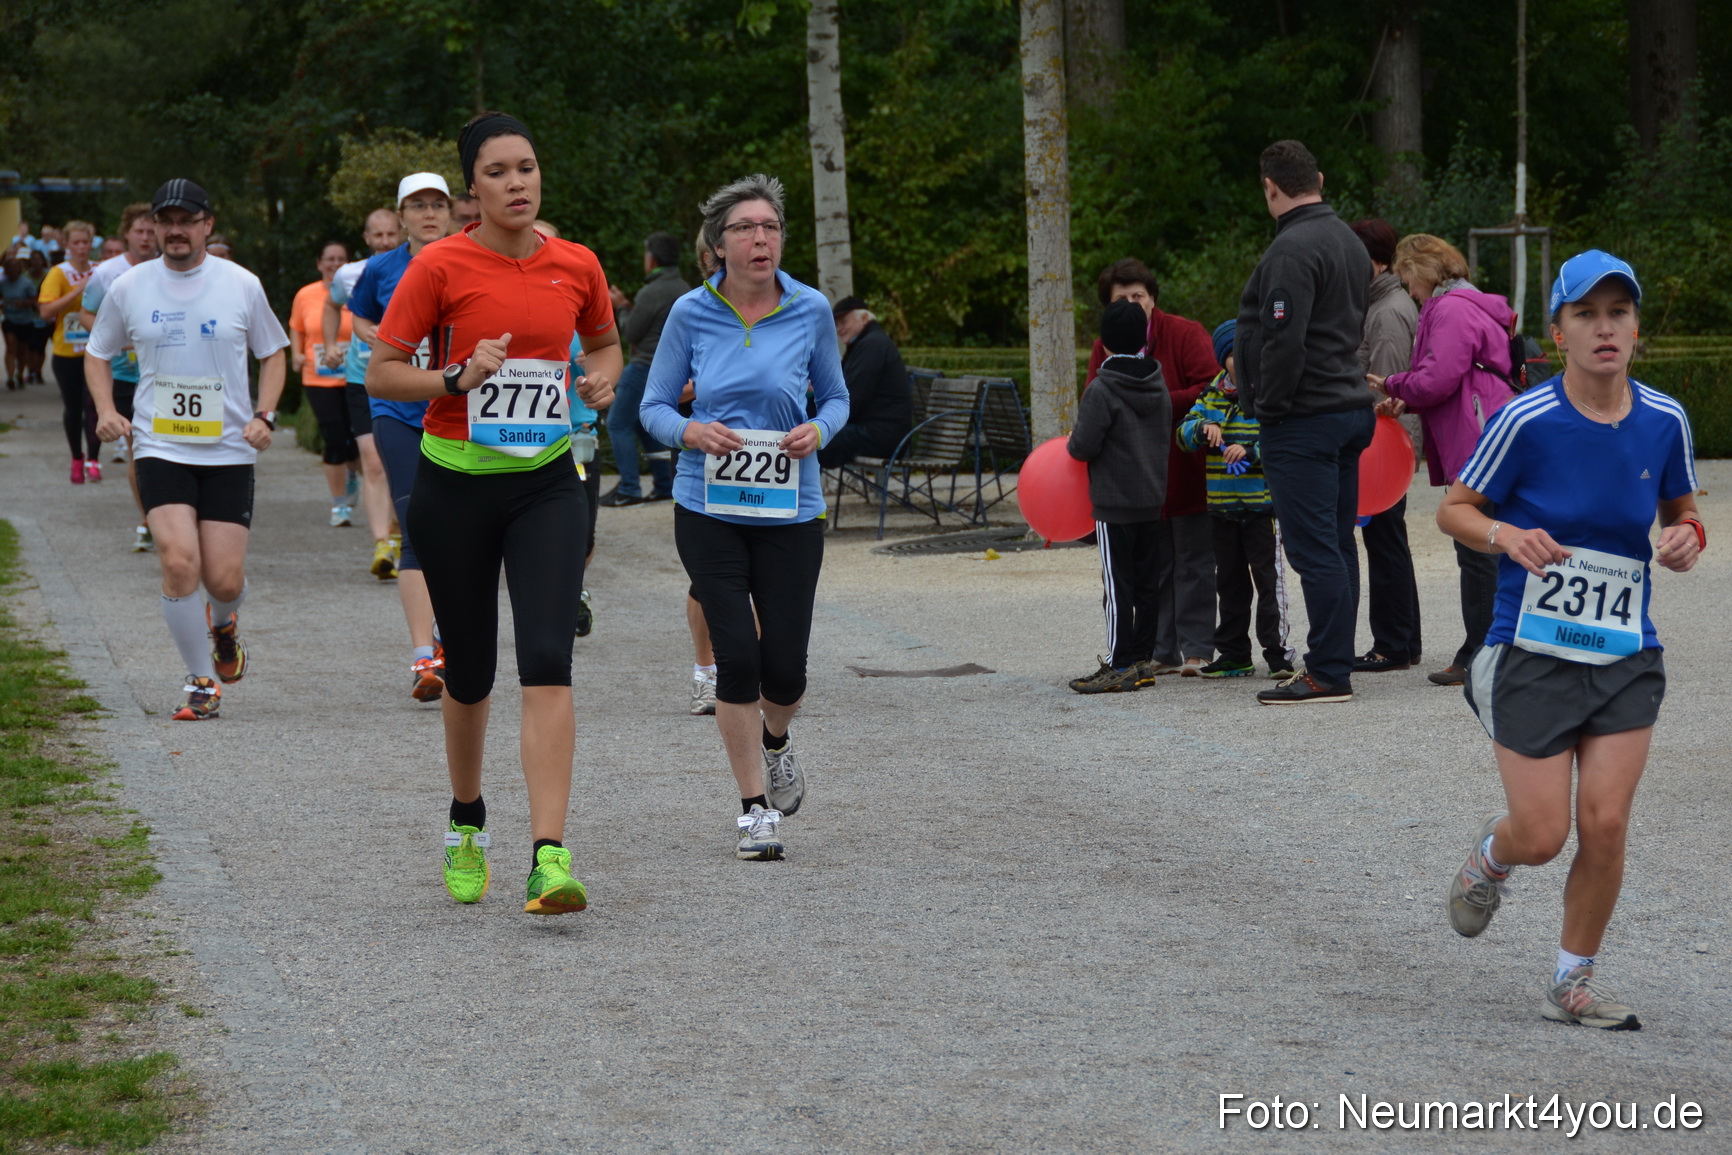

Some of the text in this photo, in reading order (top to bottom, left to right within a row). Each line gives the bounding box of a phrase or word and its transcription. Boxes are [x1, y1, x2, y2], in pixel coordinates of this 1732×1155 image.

[509, 369, 552, 379] Neumarkt
[155, 380, 212, 391] PARTL Neumarkt
[172, 393, 202, 417] 36
[480, 383, 562, 419] 2772
[173, 423, 200, 434] Heiko
[499, 428, 546, 443] Sandra
[742, 438, 780, 448] Neumark
[715, 451, 791, 485] 2229
[739, 490, 765, 505] Anni
[1579, 560, 1628, 579] Neumarkt
[1536, 571, 1632, 626] 2314
[1555, 625, 1606, 649] Nicole
